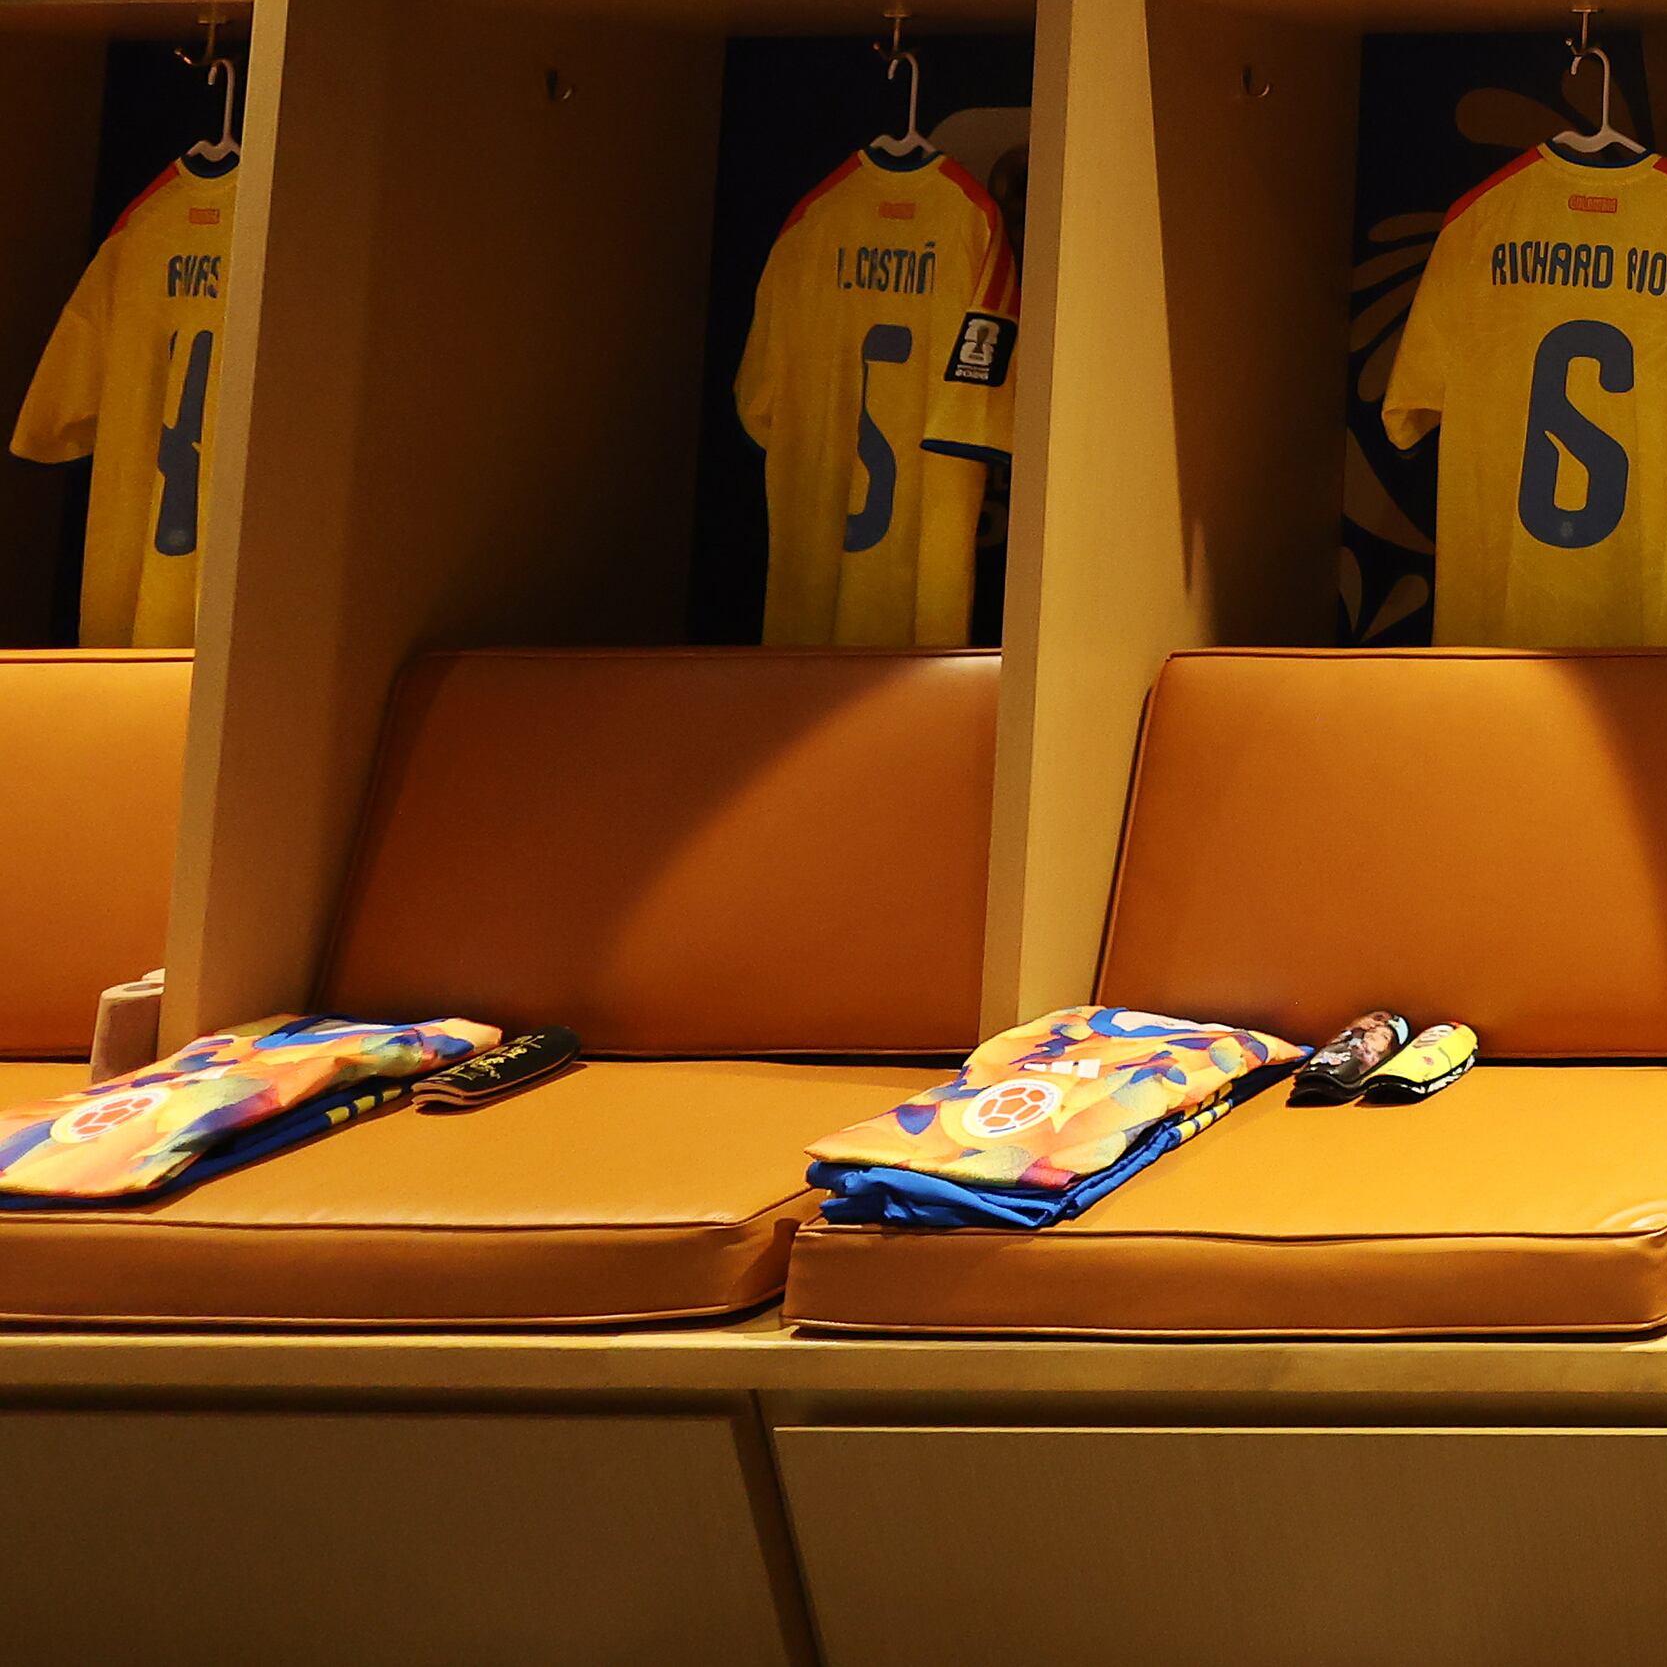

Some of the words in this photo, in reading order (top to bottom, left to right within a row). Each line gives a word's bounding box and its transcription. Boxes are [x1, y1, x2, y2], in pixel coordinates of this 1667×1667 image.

[1491, 240, 1615, 290] RICHARD
[841, 323, 913, 554] 5
[1518, 319, 1635, 550] 6
